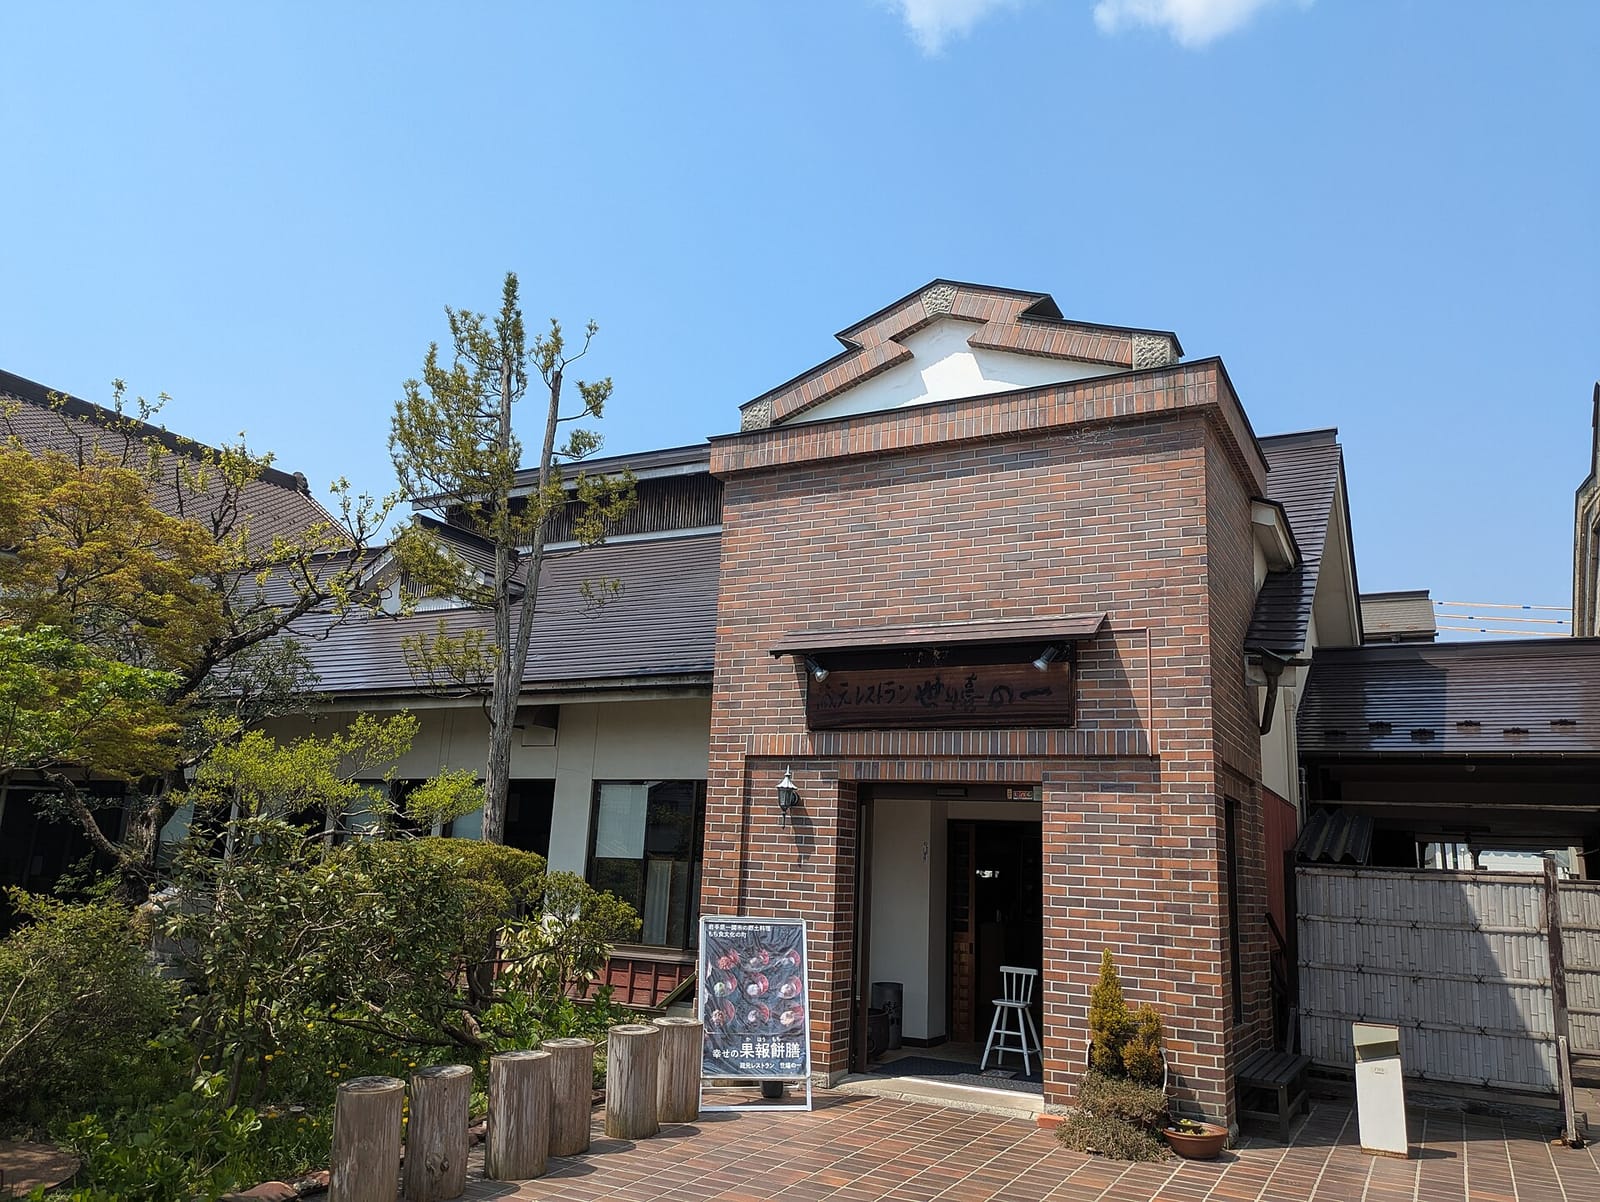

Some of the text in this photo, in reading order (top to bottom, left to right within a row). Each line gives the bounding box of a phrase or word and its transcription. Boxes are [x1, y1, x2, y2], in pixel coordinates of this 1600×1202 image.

[712, 1042, 801, 1059] 幸せの果報餅膳
